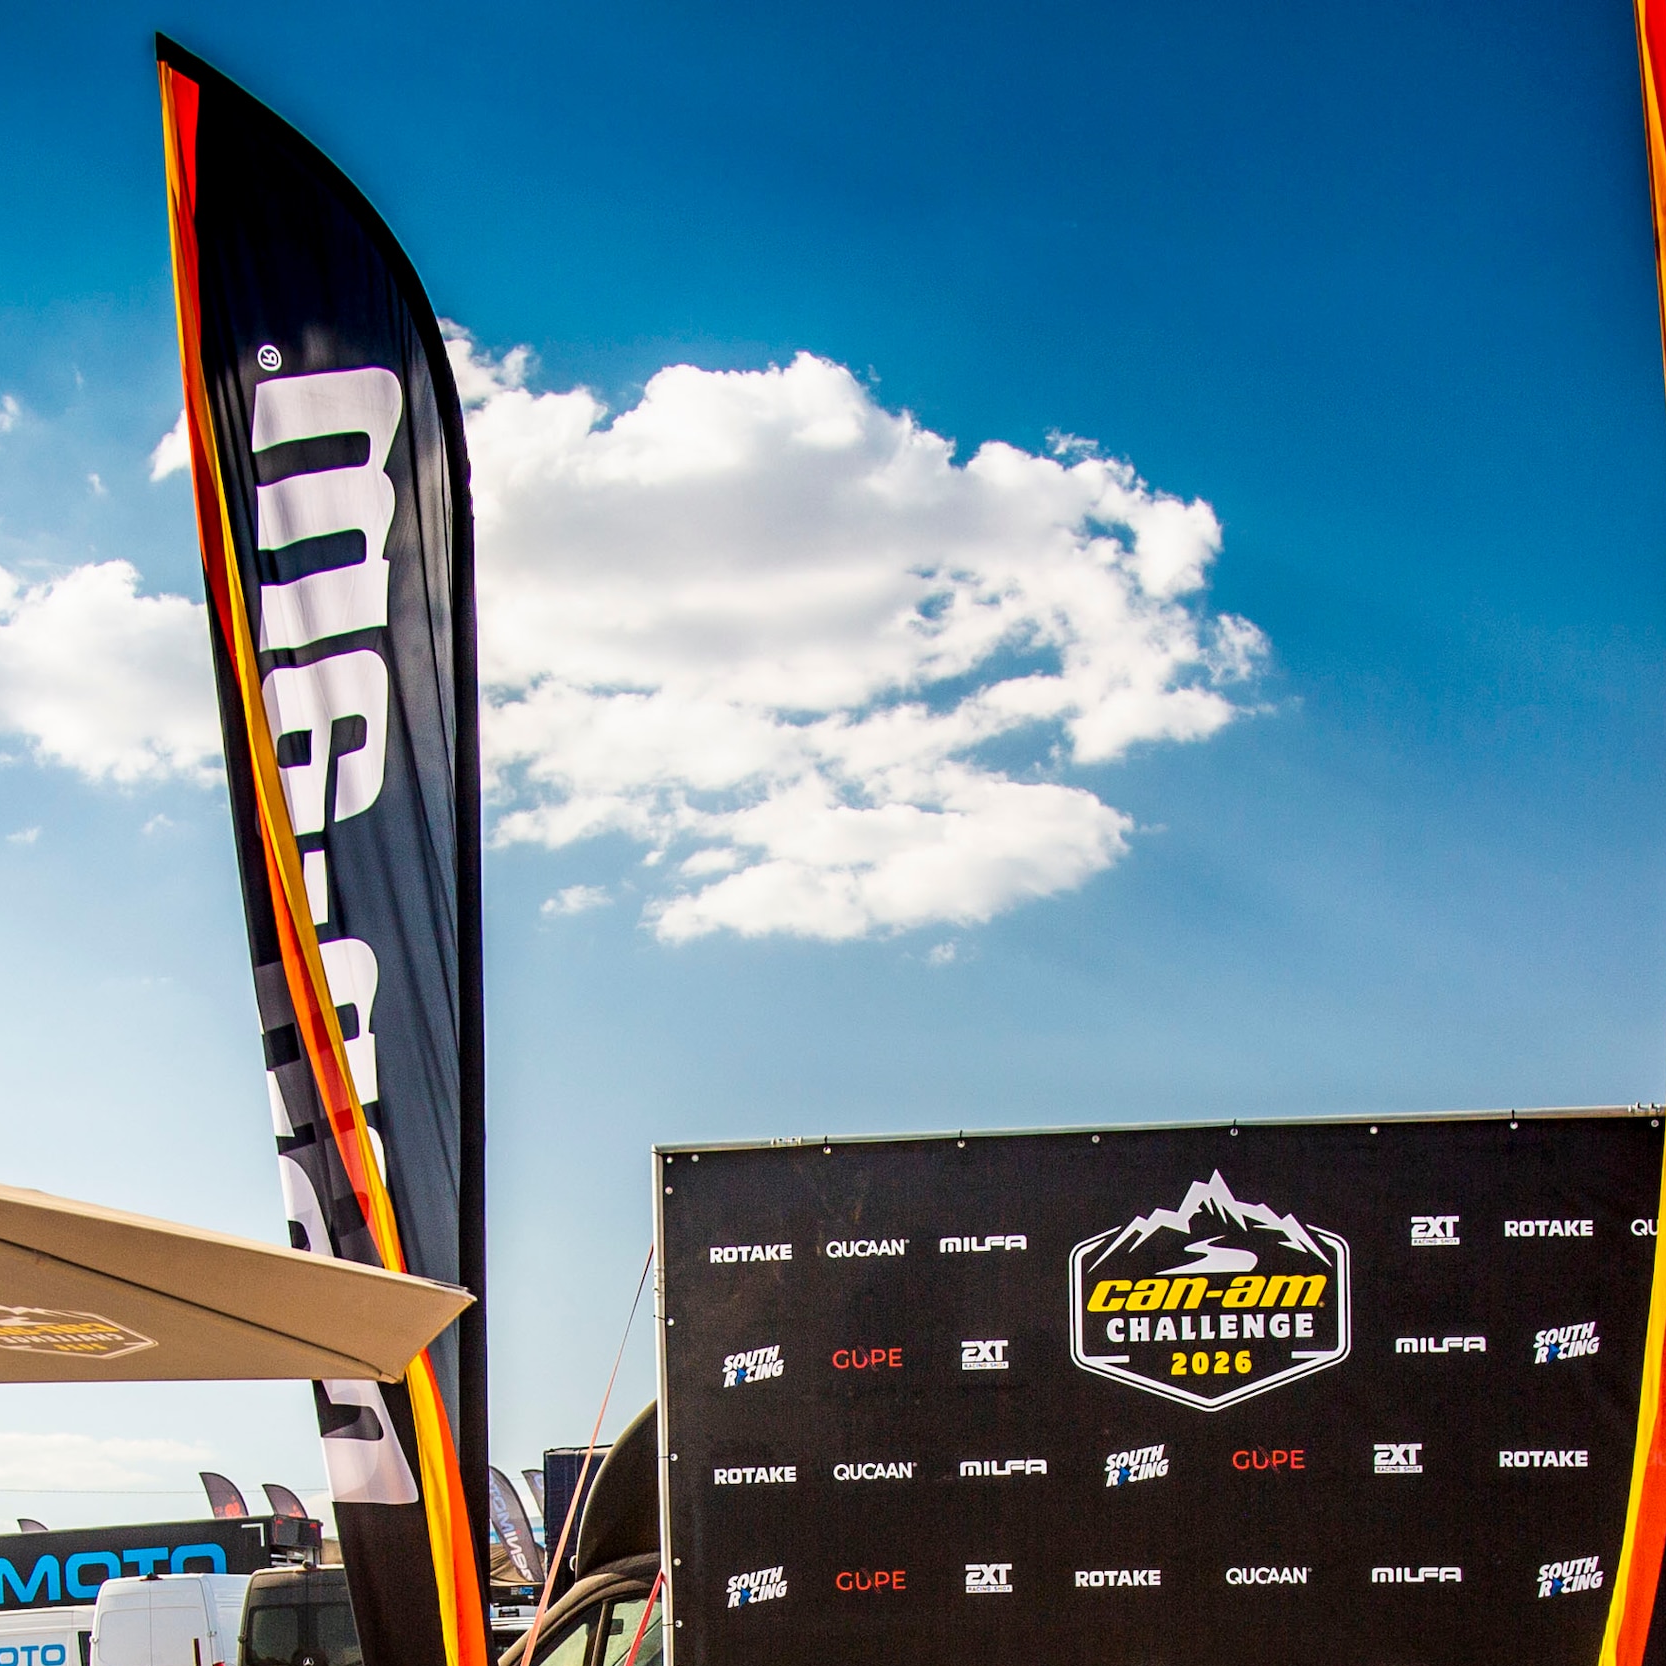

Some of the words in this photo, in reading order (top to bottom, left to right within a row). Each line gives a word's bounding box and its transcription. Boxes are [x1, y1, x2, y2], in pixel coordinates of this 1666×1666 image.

[1504, 1219, 1594, 1237] ROTAKE
[709, 1243, 793, 1264] ROTAKE
[939, 1234, 1028, 1254] MILFA
[1105, 1313, 1315, 1343] CHALLENGE
[1532, 1321, 1595, 1349] SOUTH
[1395, 1336, 1487, 1354] MILFA
[721, 1344, 781, 1372] SOUTH
[831, 1347, 903, 1370] GUPE
[1170, 1350, 1253, 1376] 2026
[959, 1459, 1048, 1477] MILFA
[1104, 1443, 1165, 1471] SOUTH
[1231, 1449, 1306, 1471] GUPE
[1499, 1450, 1589, 1468] ROTAKE
[713, 1465, 797, 1485] ROTAKE
[725, 1565, 784, 1593] SOUTH
[1074, 1569, 1162, 1588] ROTAKE
[1371, 1566, 1462, 1583] MILFA
[1536, 1555, 1599, 1583] SOUTH
[835, 1569, 907, 1592] GUPE
